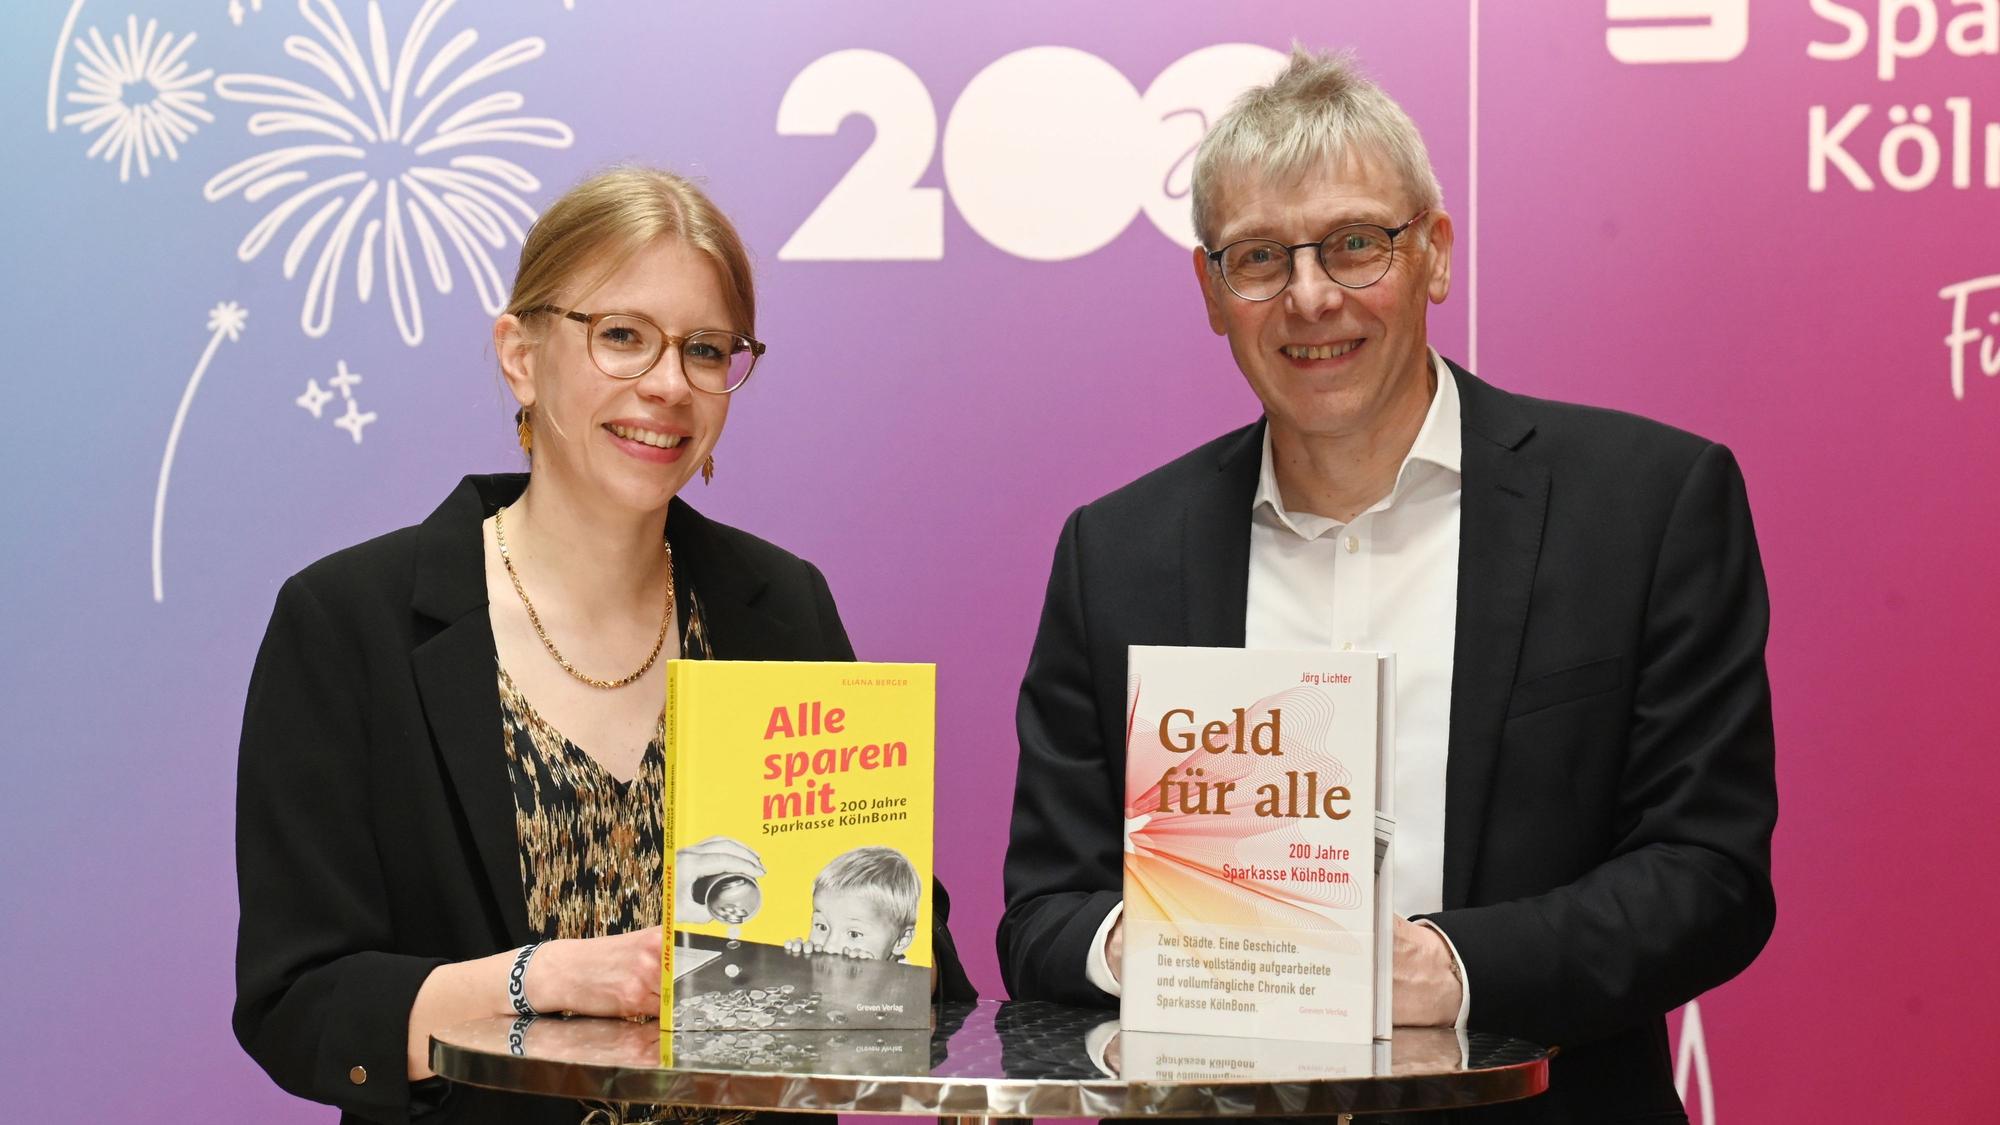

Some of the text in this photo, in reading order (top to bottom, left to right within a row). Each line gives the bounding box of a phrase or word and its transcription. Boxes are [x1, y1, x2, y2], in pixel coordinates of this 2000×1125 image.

[1300, 672, 1352, 686] Jörg Lichter
[764, 701, 846, 740] Alle
[1158, 708, 1284, 757] Geld
[764, 740, 908, 787] sparen
[762, 779, 836, 820] mit
[1156, 766, 1351, 820] für alle
[840, 796, 907, 812] 200 Jahre
[762, 810, 907, 836] Sparkasse KölnBonn
[1289, 844, 1350, 860] 200 Jahre
[1223, 864, 1350, 884] Sparkasse KölnBonn
[1158, 934, 1180, 947] Zwei
[1219, 937, 1240, 950] Eine
[1243, 939, 1300, 954] Geschichte.
[1157, 954, 1331, 976] Die erste vollständig aufgearbeitete
[1157, 975, 1316, 996] und vollumfängliche Chronik der
[856, 1003, 904, 1013] Greven Verlag
[1156, 995, 1258, 1012] Sparkasse KölnBonn.
